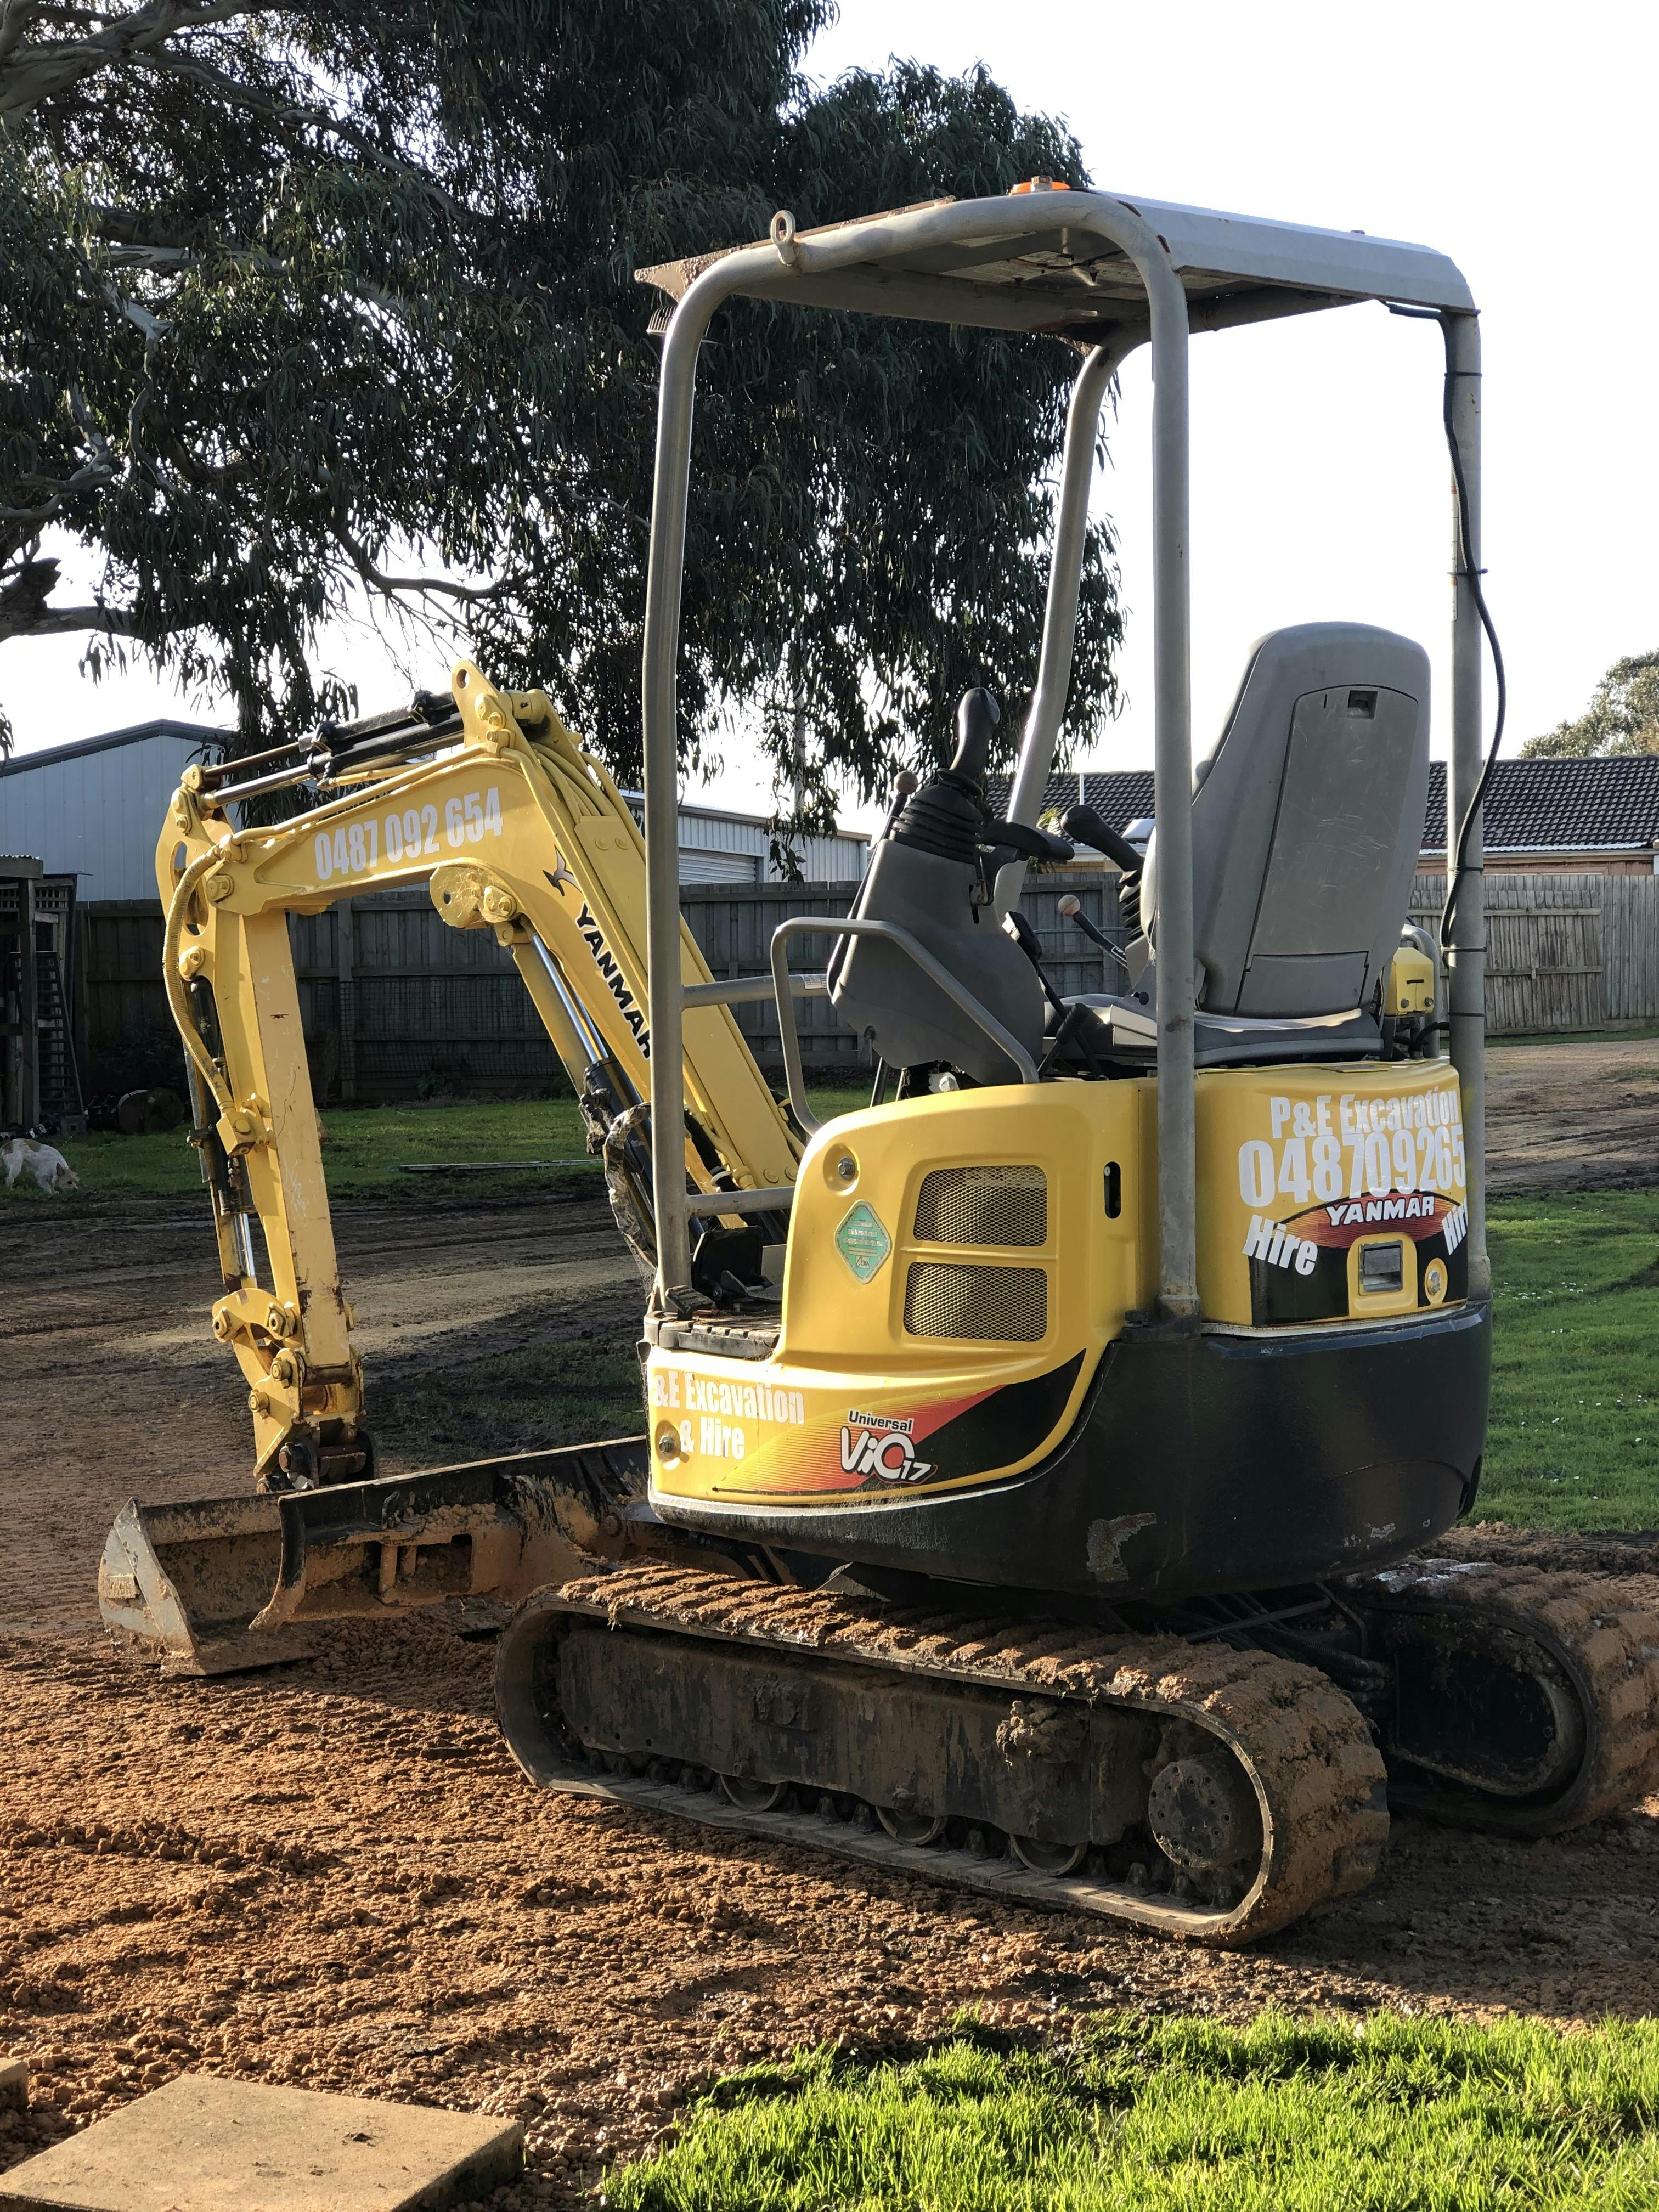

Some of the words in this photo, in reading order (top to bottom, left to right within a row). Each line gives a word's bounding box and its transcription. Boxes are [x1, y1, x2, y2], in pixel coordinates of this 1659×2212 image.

[315, 820, 378, 880] 0487
[385, 804, 440, 863] 092
[445, 787, 504, 848] 654
[1270, 1094, 1334, 1139] P&E
[1340, 1086, 1459, 1134] Excavation
[1326, 1196, 1435, 1226] YANMAR
[1442, 1196, 1469, 1256] Hir
[1242, 1214, 1318, 1276] Hire
[648, 1370, 680, 1408] &E
[684, 1372, 805, 1425] Excavation
[849, 1410, 913, 1432] Universal
[680, 1419, 695, 1453] &
[700, 1416, 746, 1460] Hire
